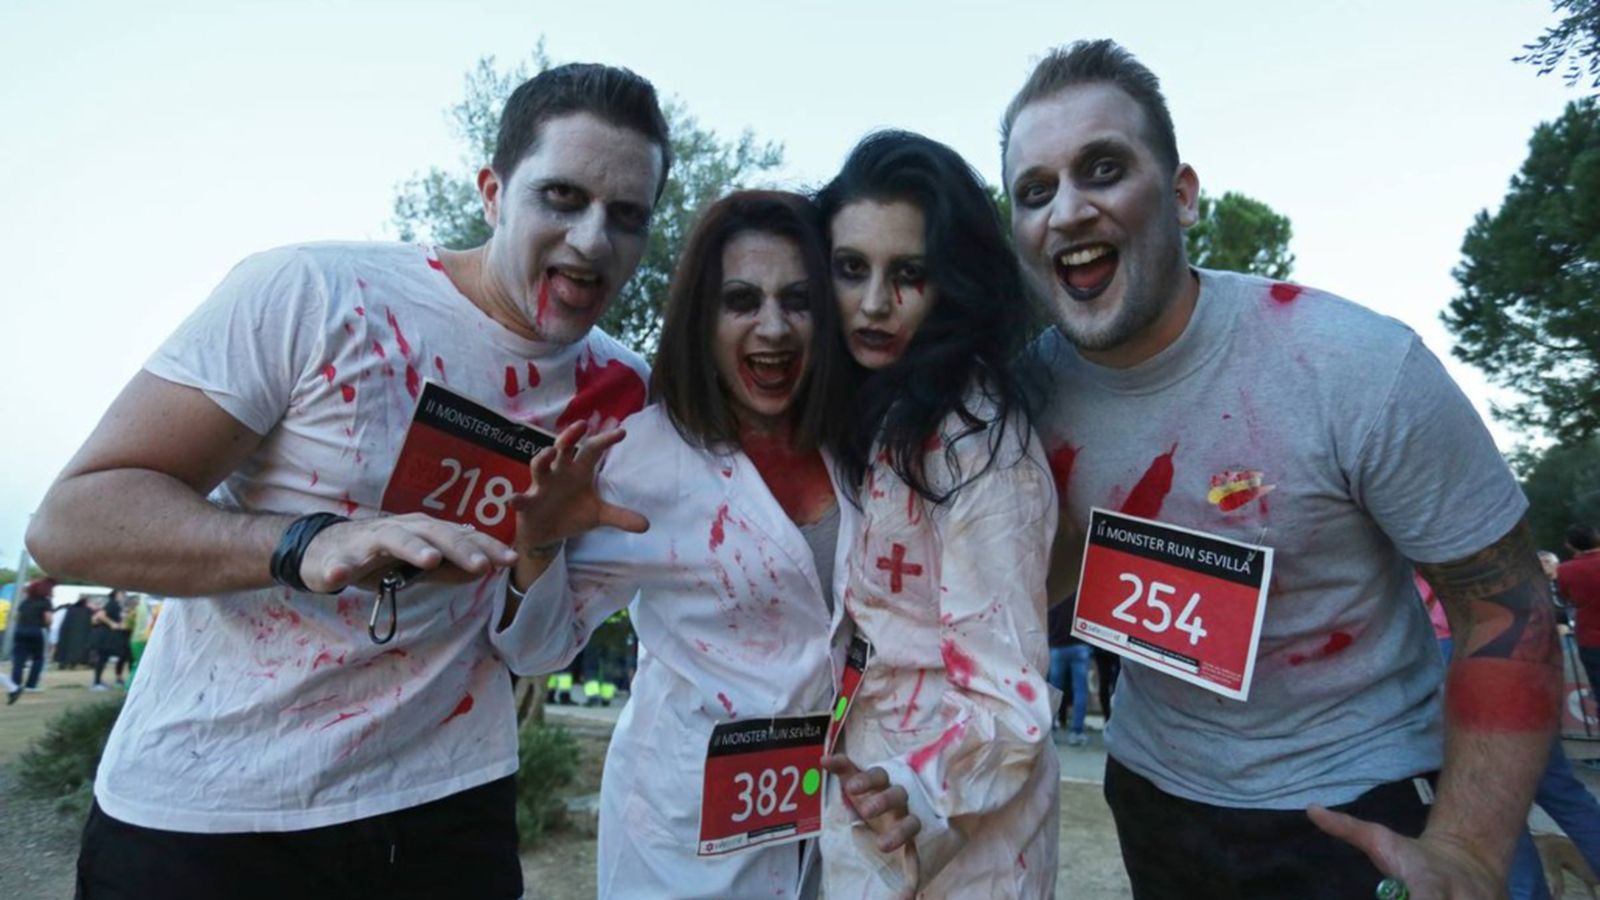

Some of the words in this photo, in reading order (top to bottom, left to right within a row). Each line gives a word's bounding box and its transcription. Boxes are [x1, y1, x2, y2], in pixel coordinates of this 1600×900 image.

[425, 400, 436, 413] II
[436, 404, 490, 437] MONSTER
[490, 426, 515, 447] RUN
[515, 438, 544, 456] SEV
[423, 458, 514, 526] 218
[1106, 527, 1165, 551] MONSTER
[1167, 541, 1196, 560] RUN
[1198, 549, 1251, 575] SEVILLA
[1111, 572, 1208, 646] 254
[721, 730, 768, 745] MONSTER
[730, 765, 800, 822] 382
